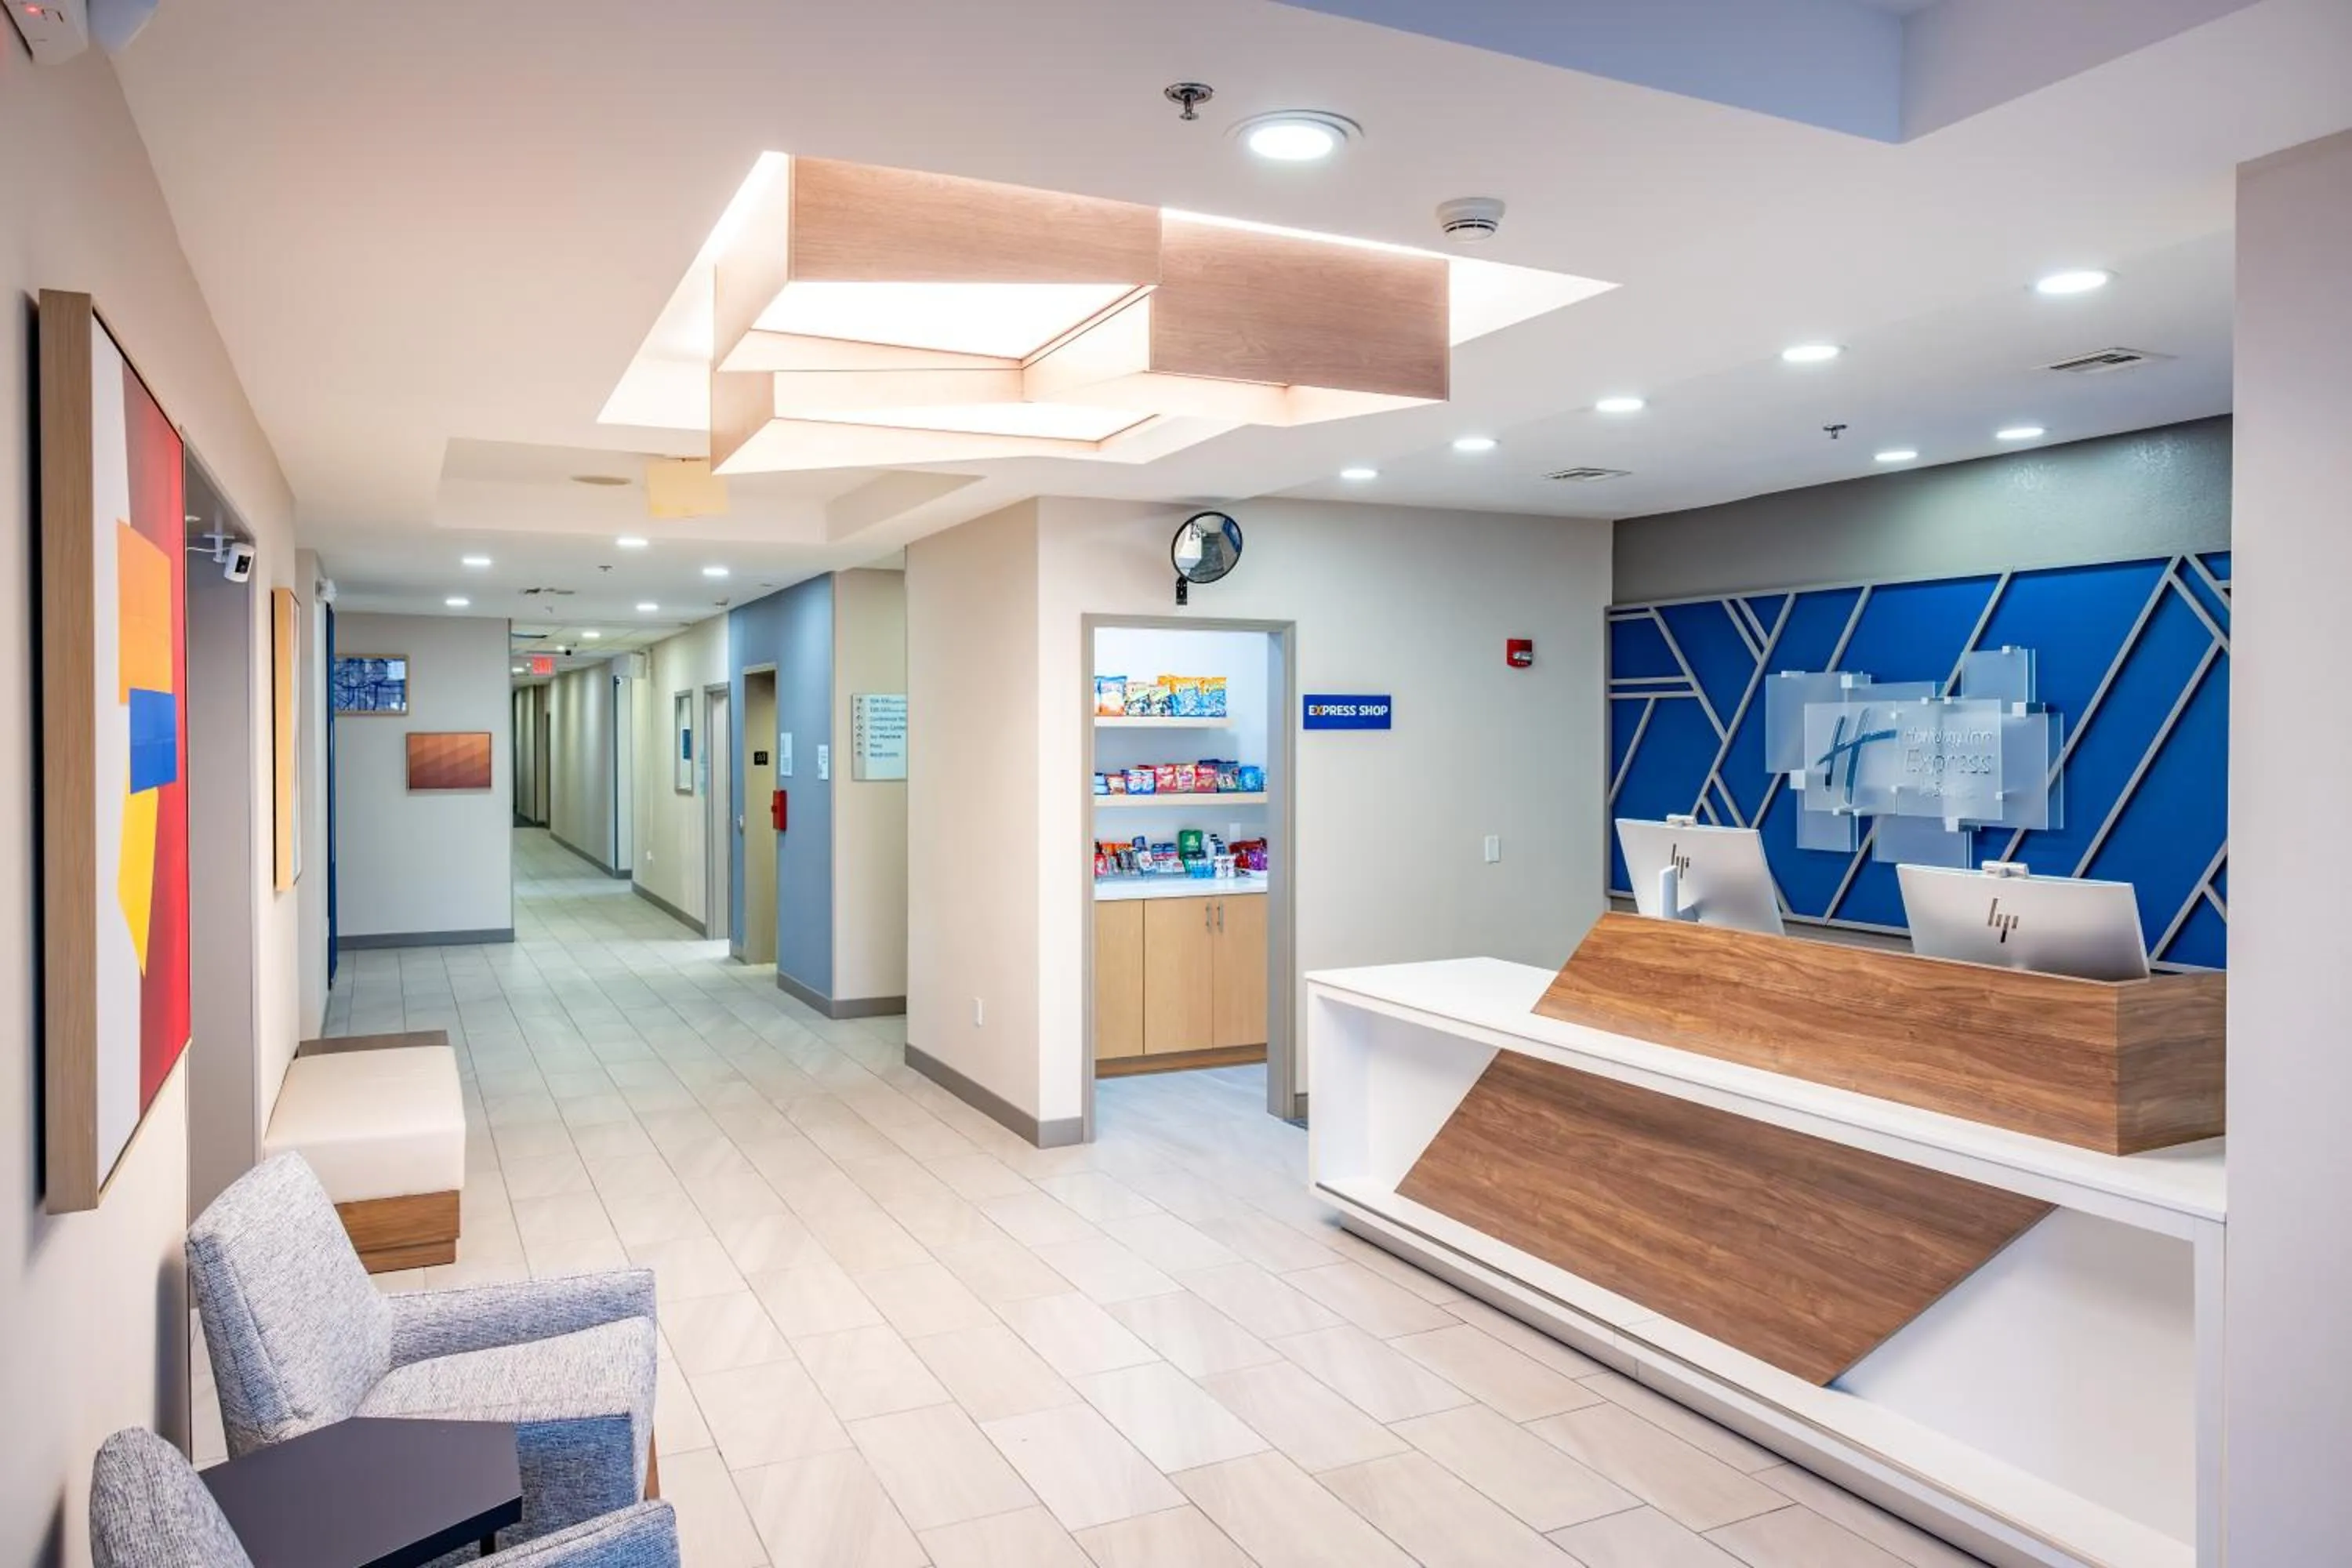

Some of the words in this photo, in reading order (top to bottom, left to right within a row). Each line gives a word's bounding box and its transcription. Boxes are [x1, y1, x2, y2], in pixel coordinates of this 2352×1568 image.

[1308, 705, 1356, 716] EXPRESS
[1359, 705, 1388, 716] SHOP
[1967, 727, 1993, 742] Inn
[1905, 748, 1993, 776] Express
[1987, 897, 2020, 944] hp
